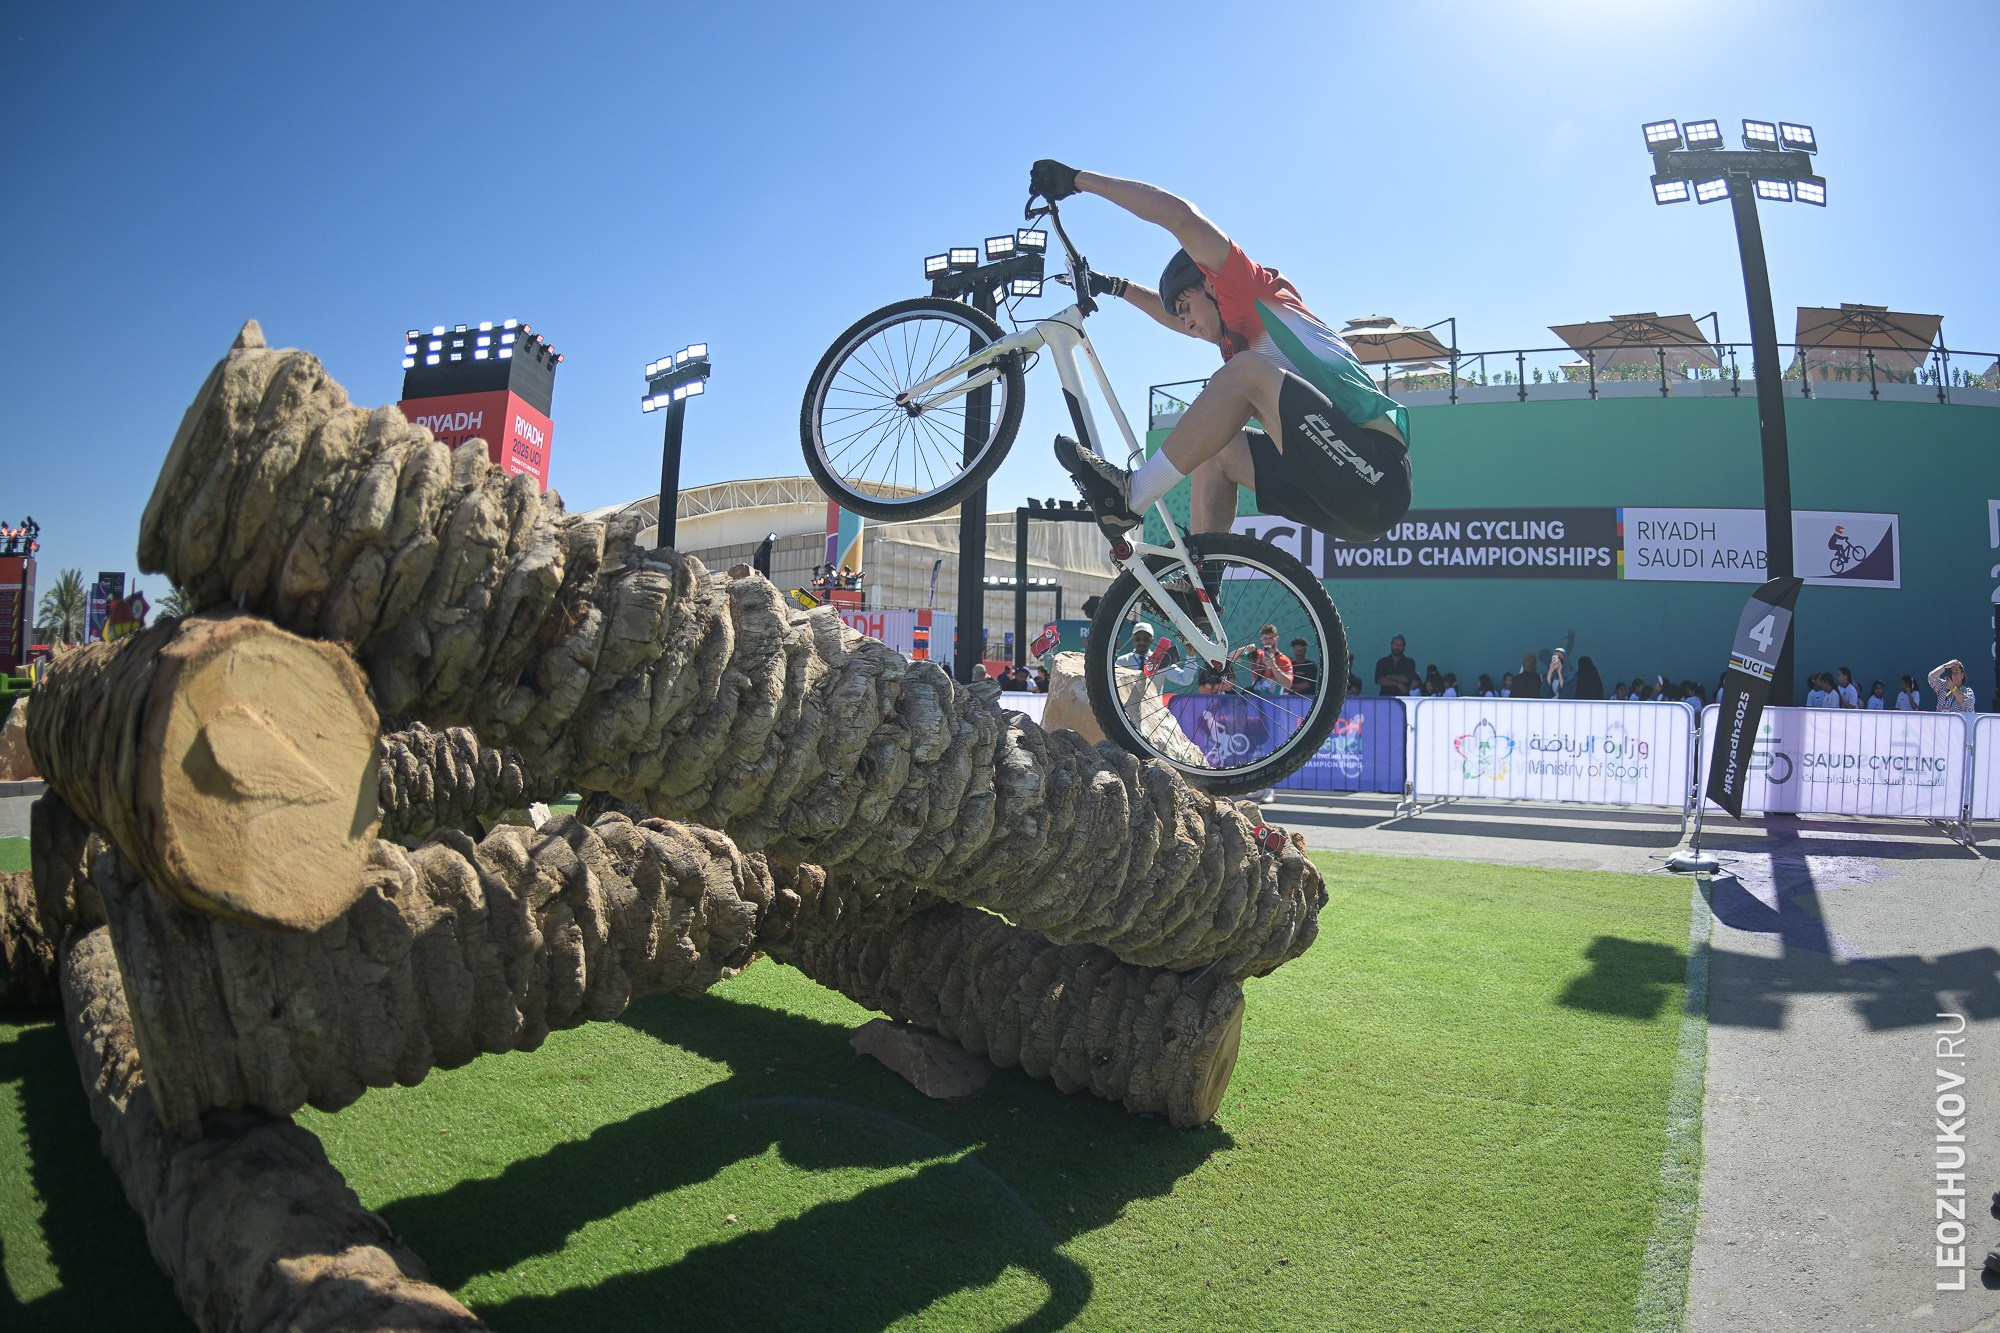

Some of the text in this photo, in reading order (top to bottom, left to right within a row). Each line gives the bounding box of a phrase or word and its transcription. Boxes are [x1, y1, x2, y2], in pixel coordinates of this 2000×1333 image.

[1317, 413, 1331, 427] TEAM
[515, 414, 544, 449] RIYADH
[512, 438, 542, 466] 2025 UCI
[1304, 413, 1385, 483] CLEAN
[1386, 520, 1565, 542] URBAN CYCLING
[1637, 521, 1716, 541] RIYADH
[1334, 547, 1611, 567] WORLD CHAMPIONSHIPS
[1637, 548, 1769, 570] SAUDI ARAB
[1748, 614, 1775, 653] 4
[1743, 659, 1763, 675] UCI
[1529, 734, 1649, 760] وزارة الرياضة
[1723, 691, 1750, 795] #Riyadh2025
[1528, 760, 1649, 781] Ministry of Sport
[1802, 753, 1946, 772] SAUDI CYCLING
